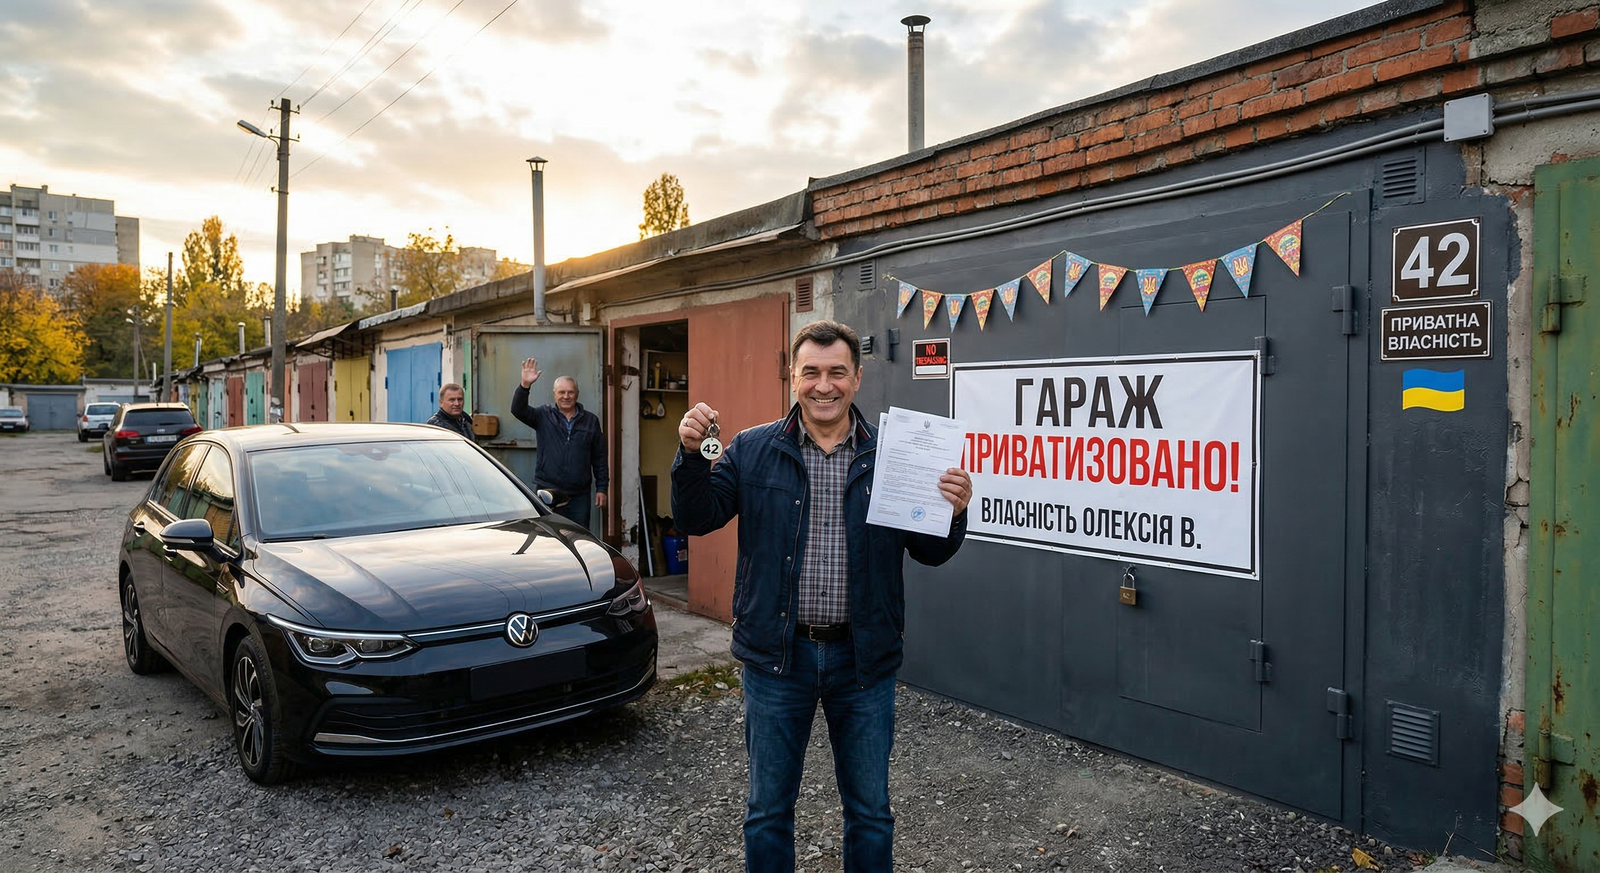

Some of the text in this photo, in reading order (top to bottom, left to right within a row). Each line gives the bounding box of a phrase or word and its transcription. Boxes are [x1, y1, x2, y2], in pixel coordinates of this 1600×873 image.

[1400, 232, 1470, 289] 42
[1391, 312, 1480, 332] ПРИВАТНА
[925, 343, 937, 356] NO
[1388, 332, 1483, 351] ВЛАСНІСТЬ
[1015, 374, 1164, 429] ГАРАЖ
[702, 443, 719, 455] 42
[960, 432, 1240, 493] ПРИВАТИЗОВАНО!
[981, 497, 1202, 550] ВЛАСНІСТЬ ОЛЕКСІЯ В.
